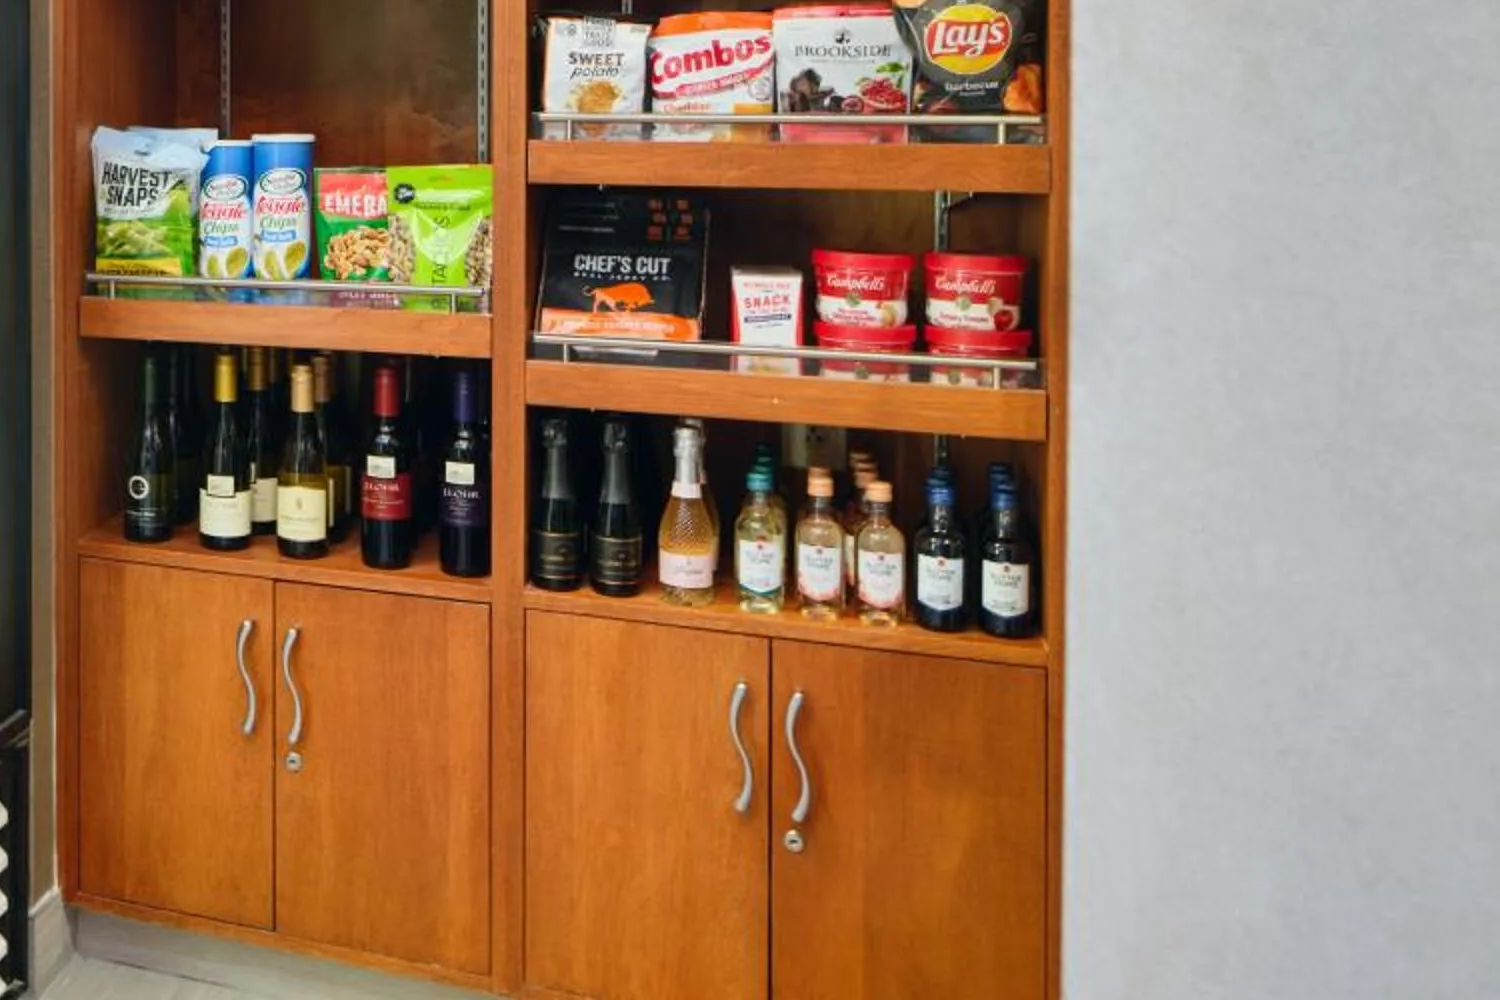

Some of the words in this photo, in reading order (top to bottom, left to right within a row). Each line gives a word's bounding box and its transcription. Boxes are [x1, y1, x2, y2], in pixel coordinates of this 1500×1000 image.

[931, 21, 1006, 57] Lay's
[568, 52, 625, 67] SWEET
[651, 36, 772, 85] Combos
[794, 43, 892, 60] BROOKSIDE
[570, 66, 619, 80] potato
[101, 161, 173, 188] HARVEST
[107, 185, 159, 207] SNAPS
[324, 190, 389, 218] EMERA
[573, 253, 633, 275] CHEF'S
[636, 256, 672, 276] CUT
[826, 272, 886, 292] Campbell's
[934, 273, 997, 295] Campbell's
